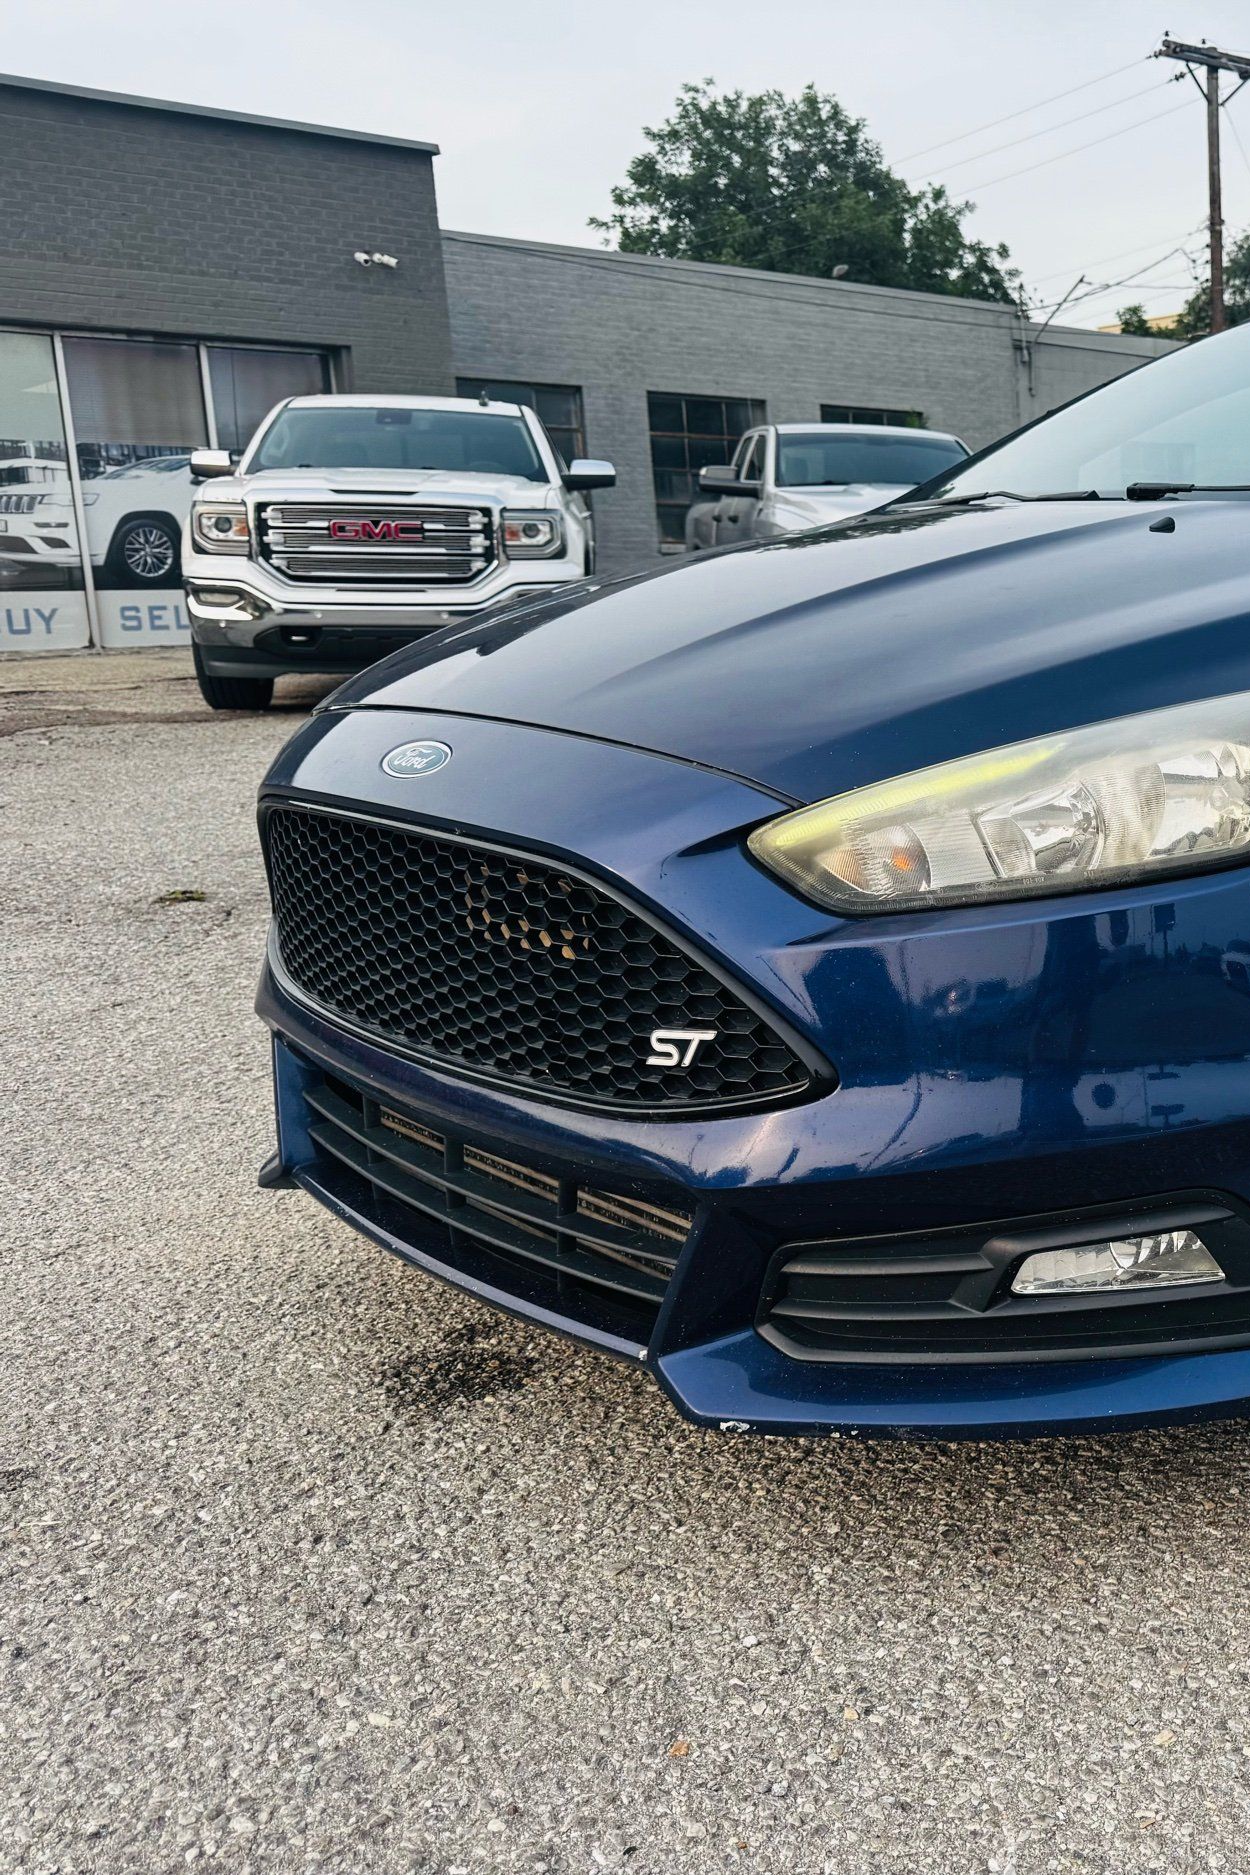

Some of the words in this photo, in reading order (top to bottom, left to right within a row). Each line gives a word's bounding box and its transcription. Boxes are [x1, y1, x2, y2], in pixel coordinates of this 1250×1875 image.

[330, 520, 423, 540] GMC
[0, 608, 58, 634] UY
[119, 605, 191, 631] SEL
[393, 747, 436, 769] Ford
[646, 1029, 718, 1067] ST
